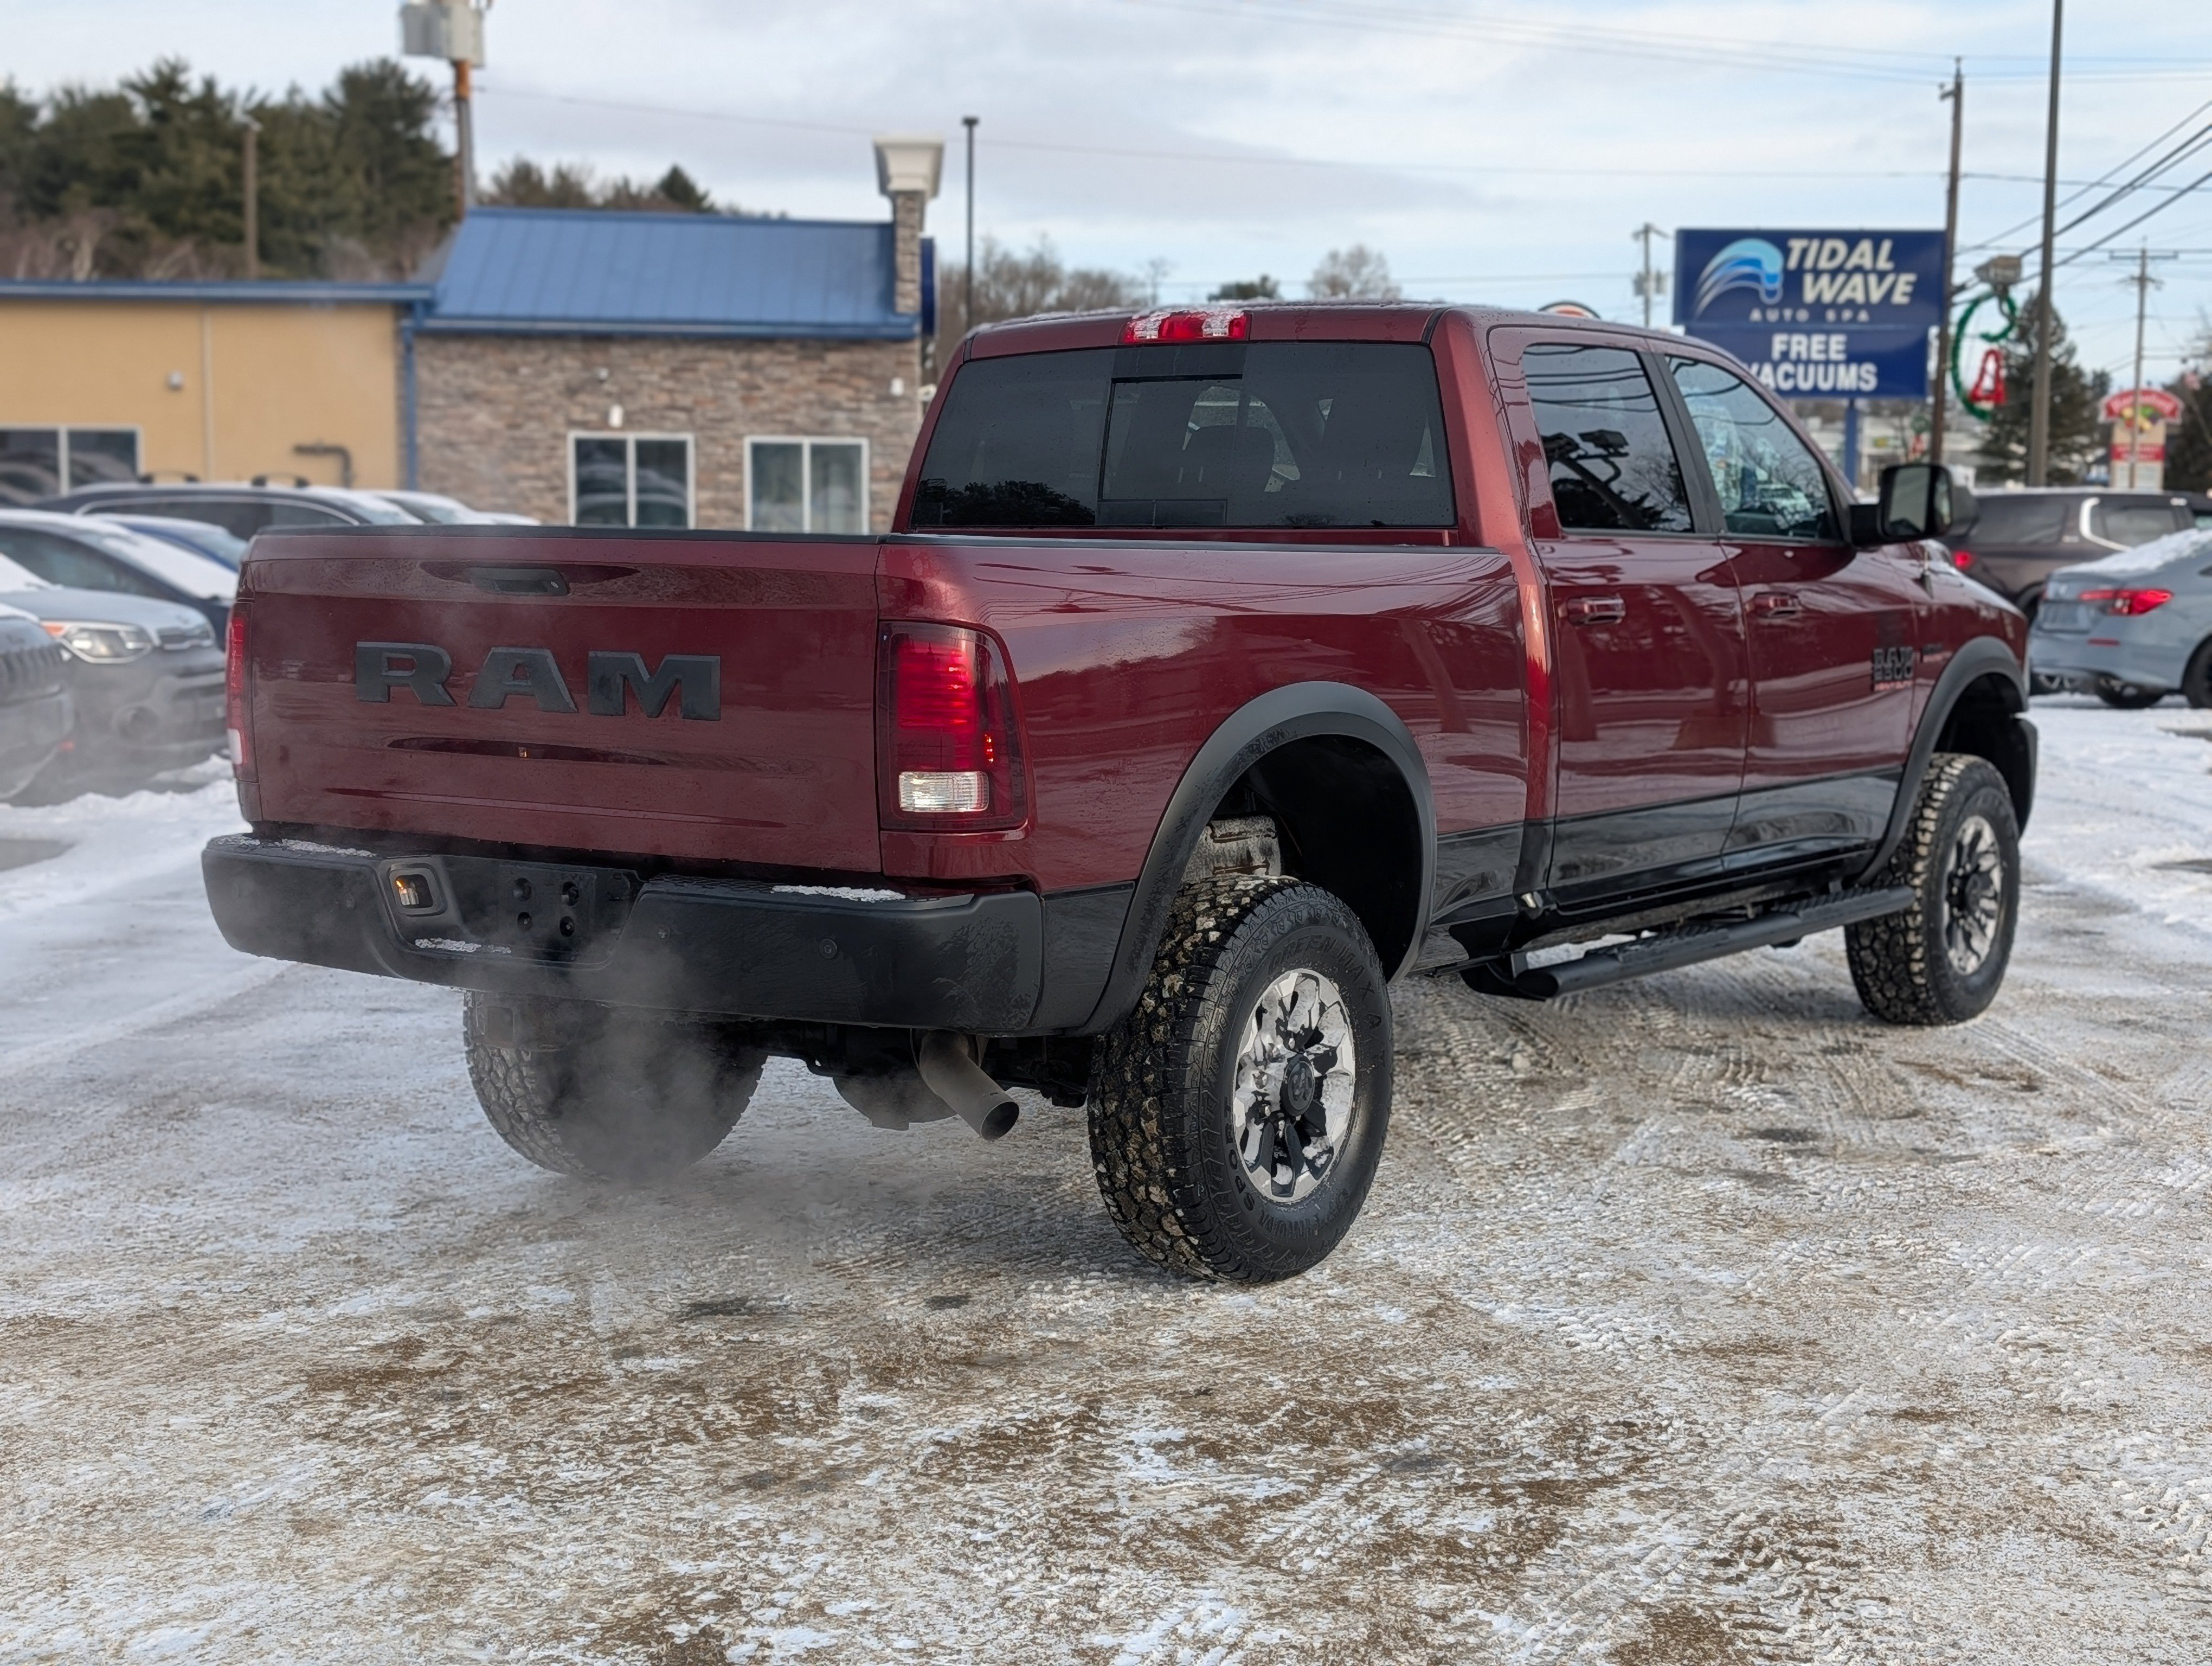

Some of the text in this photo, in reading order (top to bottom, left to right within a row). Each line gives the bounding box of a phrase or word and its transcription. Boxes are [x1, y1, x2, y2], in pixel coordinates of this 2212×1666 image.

[1787, 239, 1895, 271] TIDAL
[1803, 273, 1917, 304] WAVE
[1750, 309, 1870, 323] AUTO SPA
[1771, 334, 1847, 361] FREE
[356, 641, 721, 721] RAM
[1224, 1095, 1256, 1212] SPORT
